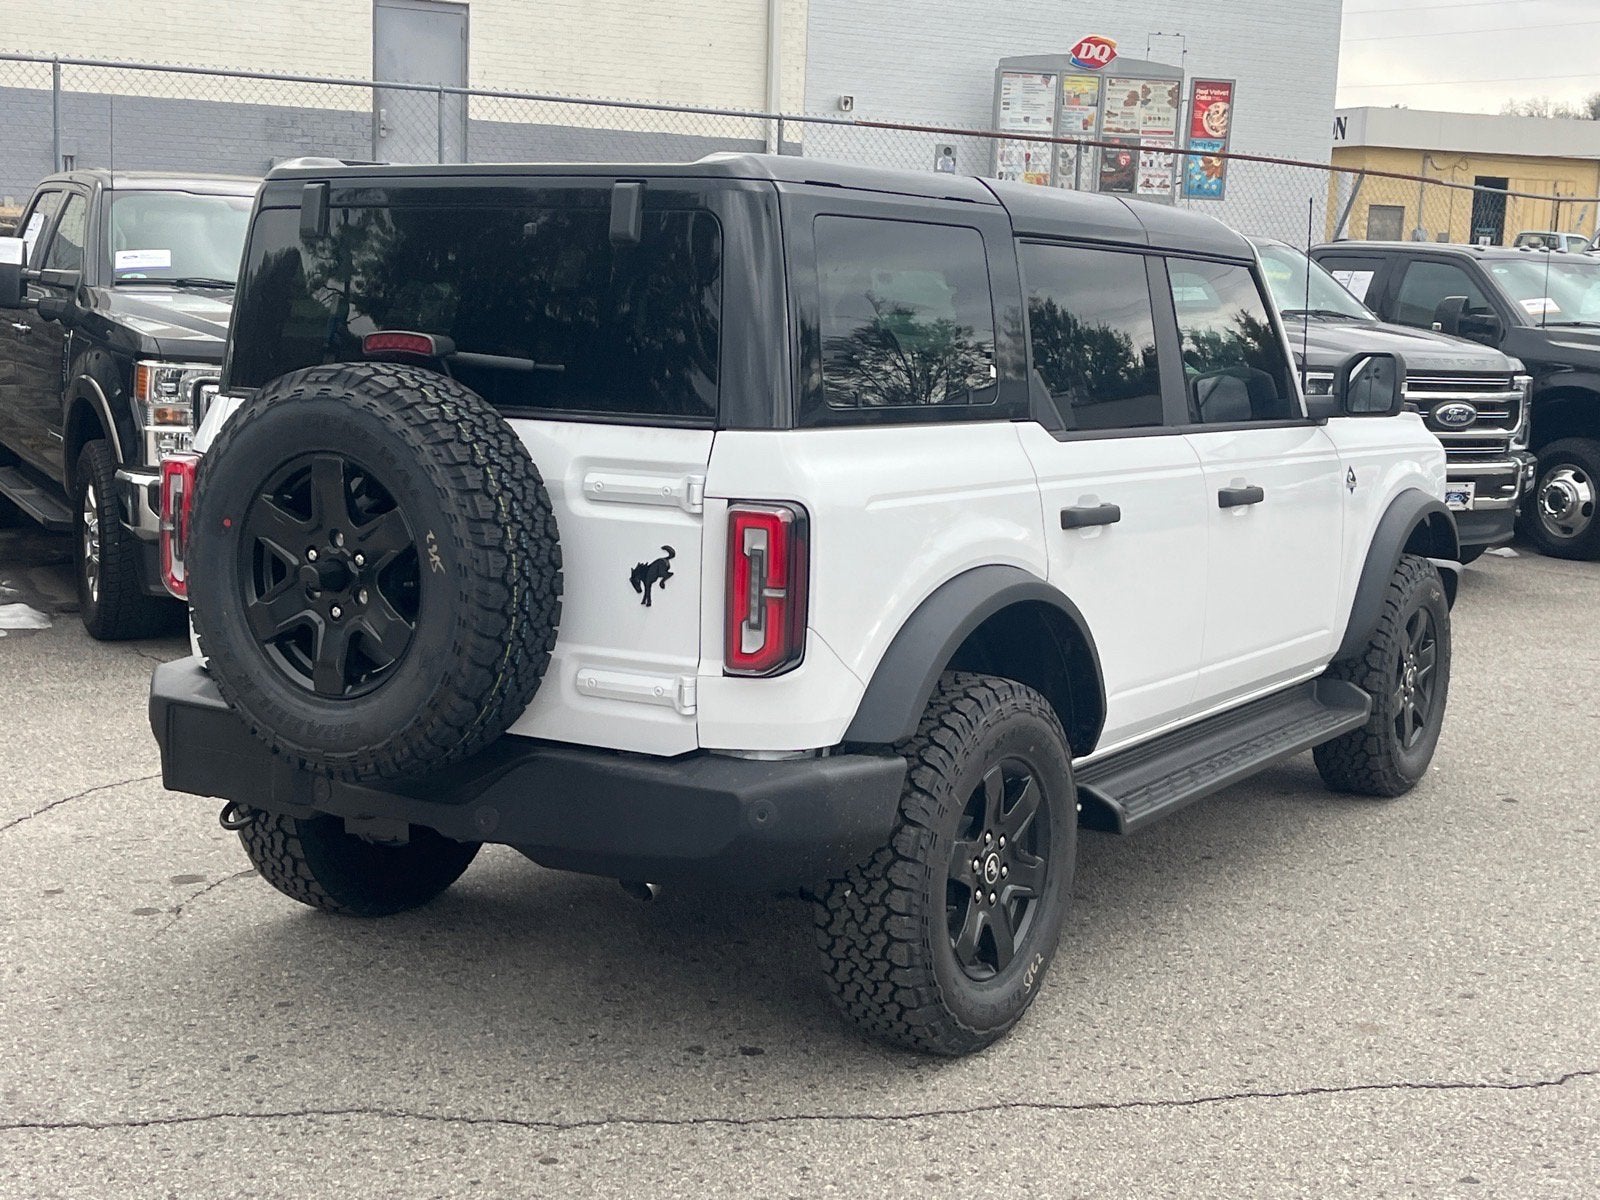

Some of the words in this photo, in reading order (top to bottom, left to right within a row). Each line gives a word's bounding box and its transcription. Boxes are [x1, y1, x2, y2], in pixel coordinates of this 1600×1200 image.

[1077, 42, 1111, 63] DQ
[1209, 88, 1229, 97] Velvet
[1446, 408, 1469, 422] Ford
